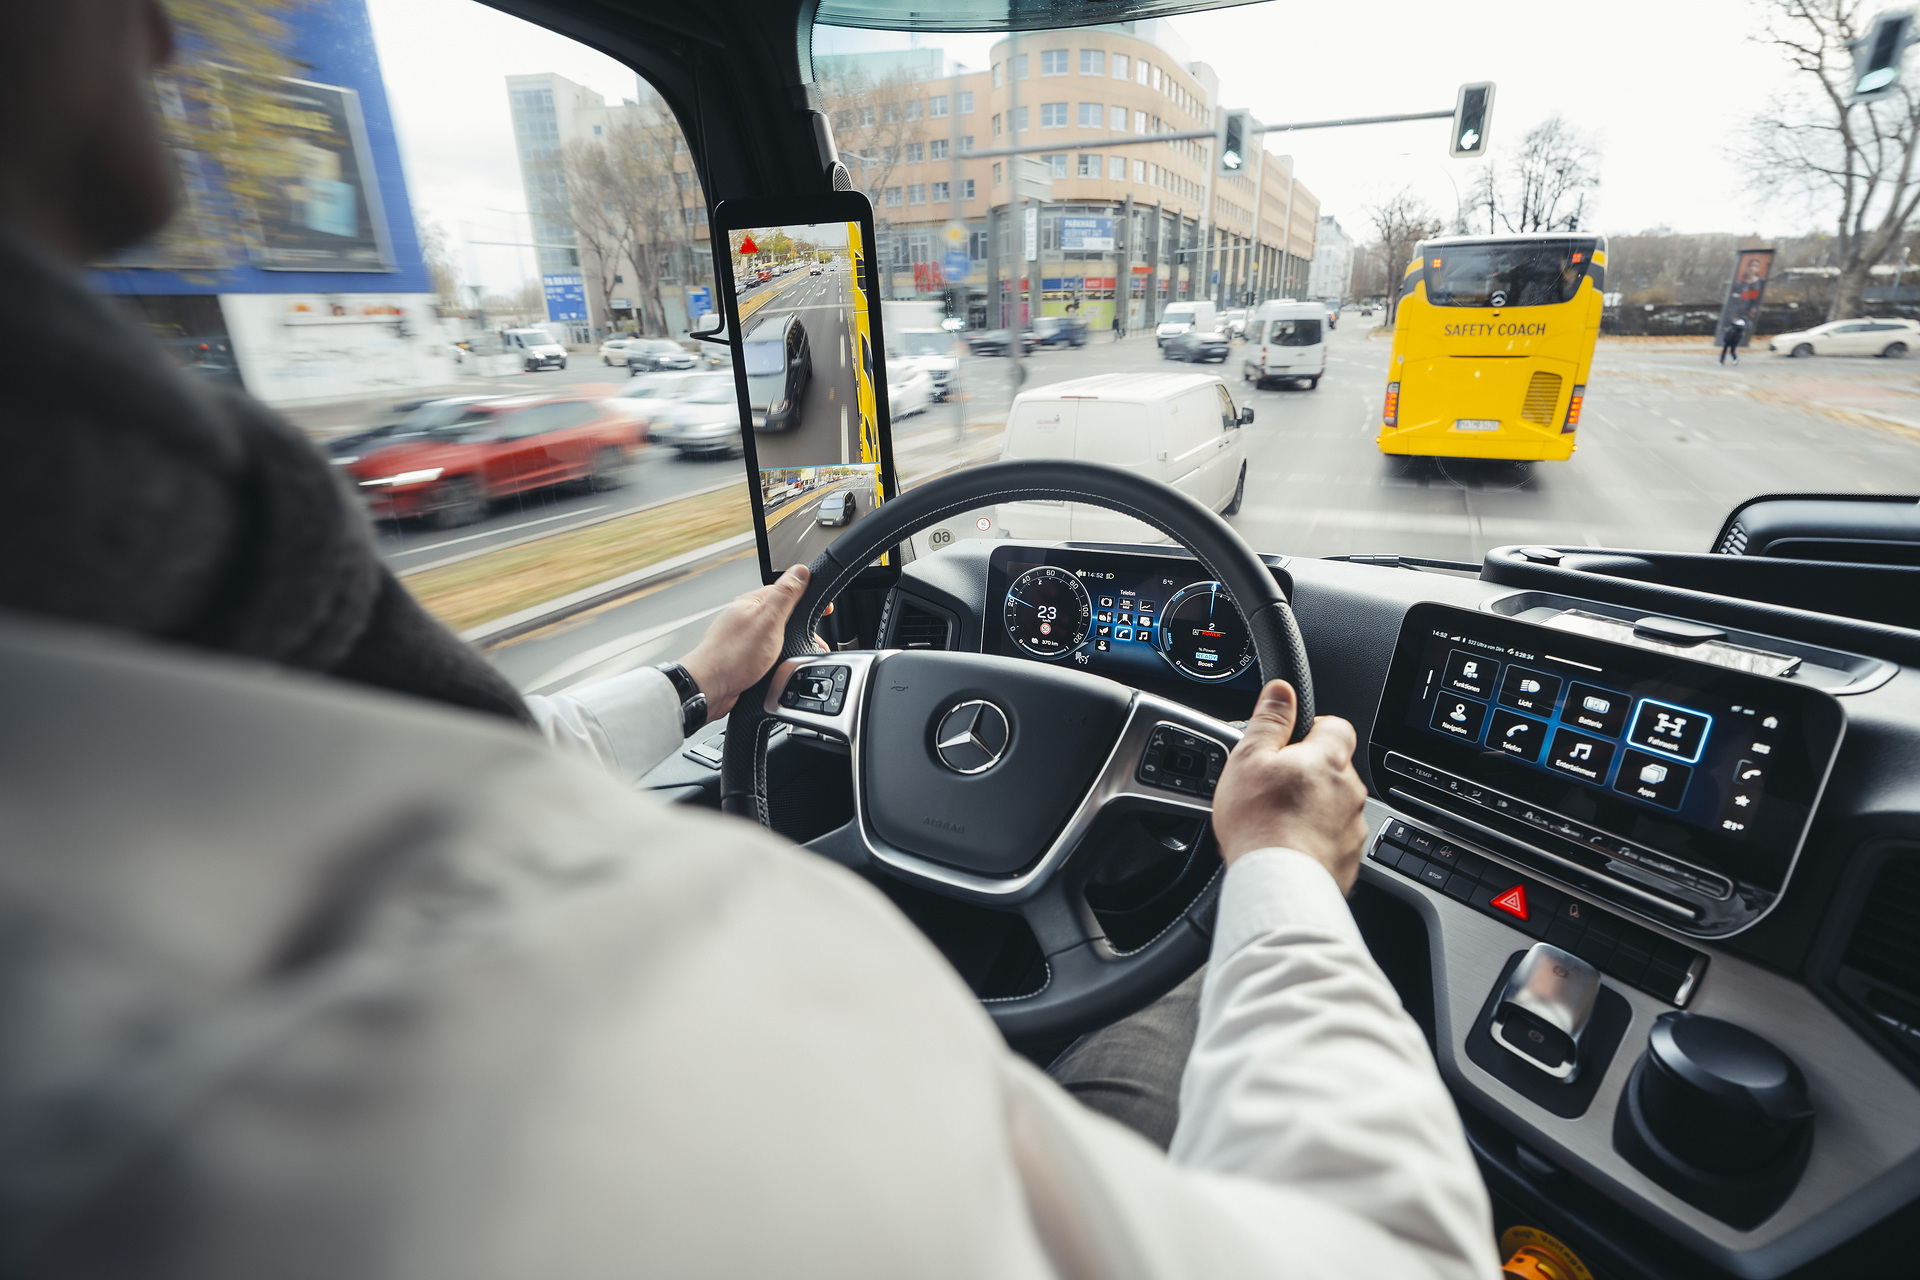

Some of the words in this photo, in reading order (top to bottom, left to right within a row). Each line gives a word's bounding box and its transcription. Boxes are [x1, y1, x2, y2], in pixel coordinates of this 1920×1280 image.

[1444, 324, 1495, 336] SAFETY
[1498, 323, 1546, 336] COACH
[1022, 575, 1031, 584] 40
[1069, 580, 1079, 590] 80
[1007, 597, 1015, 607] 20
[1037, 605, 1057, 620] 23
[1208, 622, 1216, 631] 2
[1073, 633, 1084, 644] 120
[1432, 629, 1449, 639] 14:52
[1198, 660, 1214, 668] Boost
[1239, 654, 1252, 667] 100
[1453, 680, 1481, 693] Funktionen
[1517, 699, 1533, 708] Licht
[1441, 721, 1468, 735] Navigation
[1578, 716, 1603, 729] Batterie
[1502, 741, 1523, 753] Telefon
[1647, 736, 1680, 752] Fahrwerk
[1415, 768, 1433, 779] TEMP
[1555, 759, 1597, 778] Entertainment
[1637, 786, 1657, 799] Apps
[922, 815, 966, 833] AIRBAG
[1428, 871, 1443, 881] STOP
